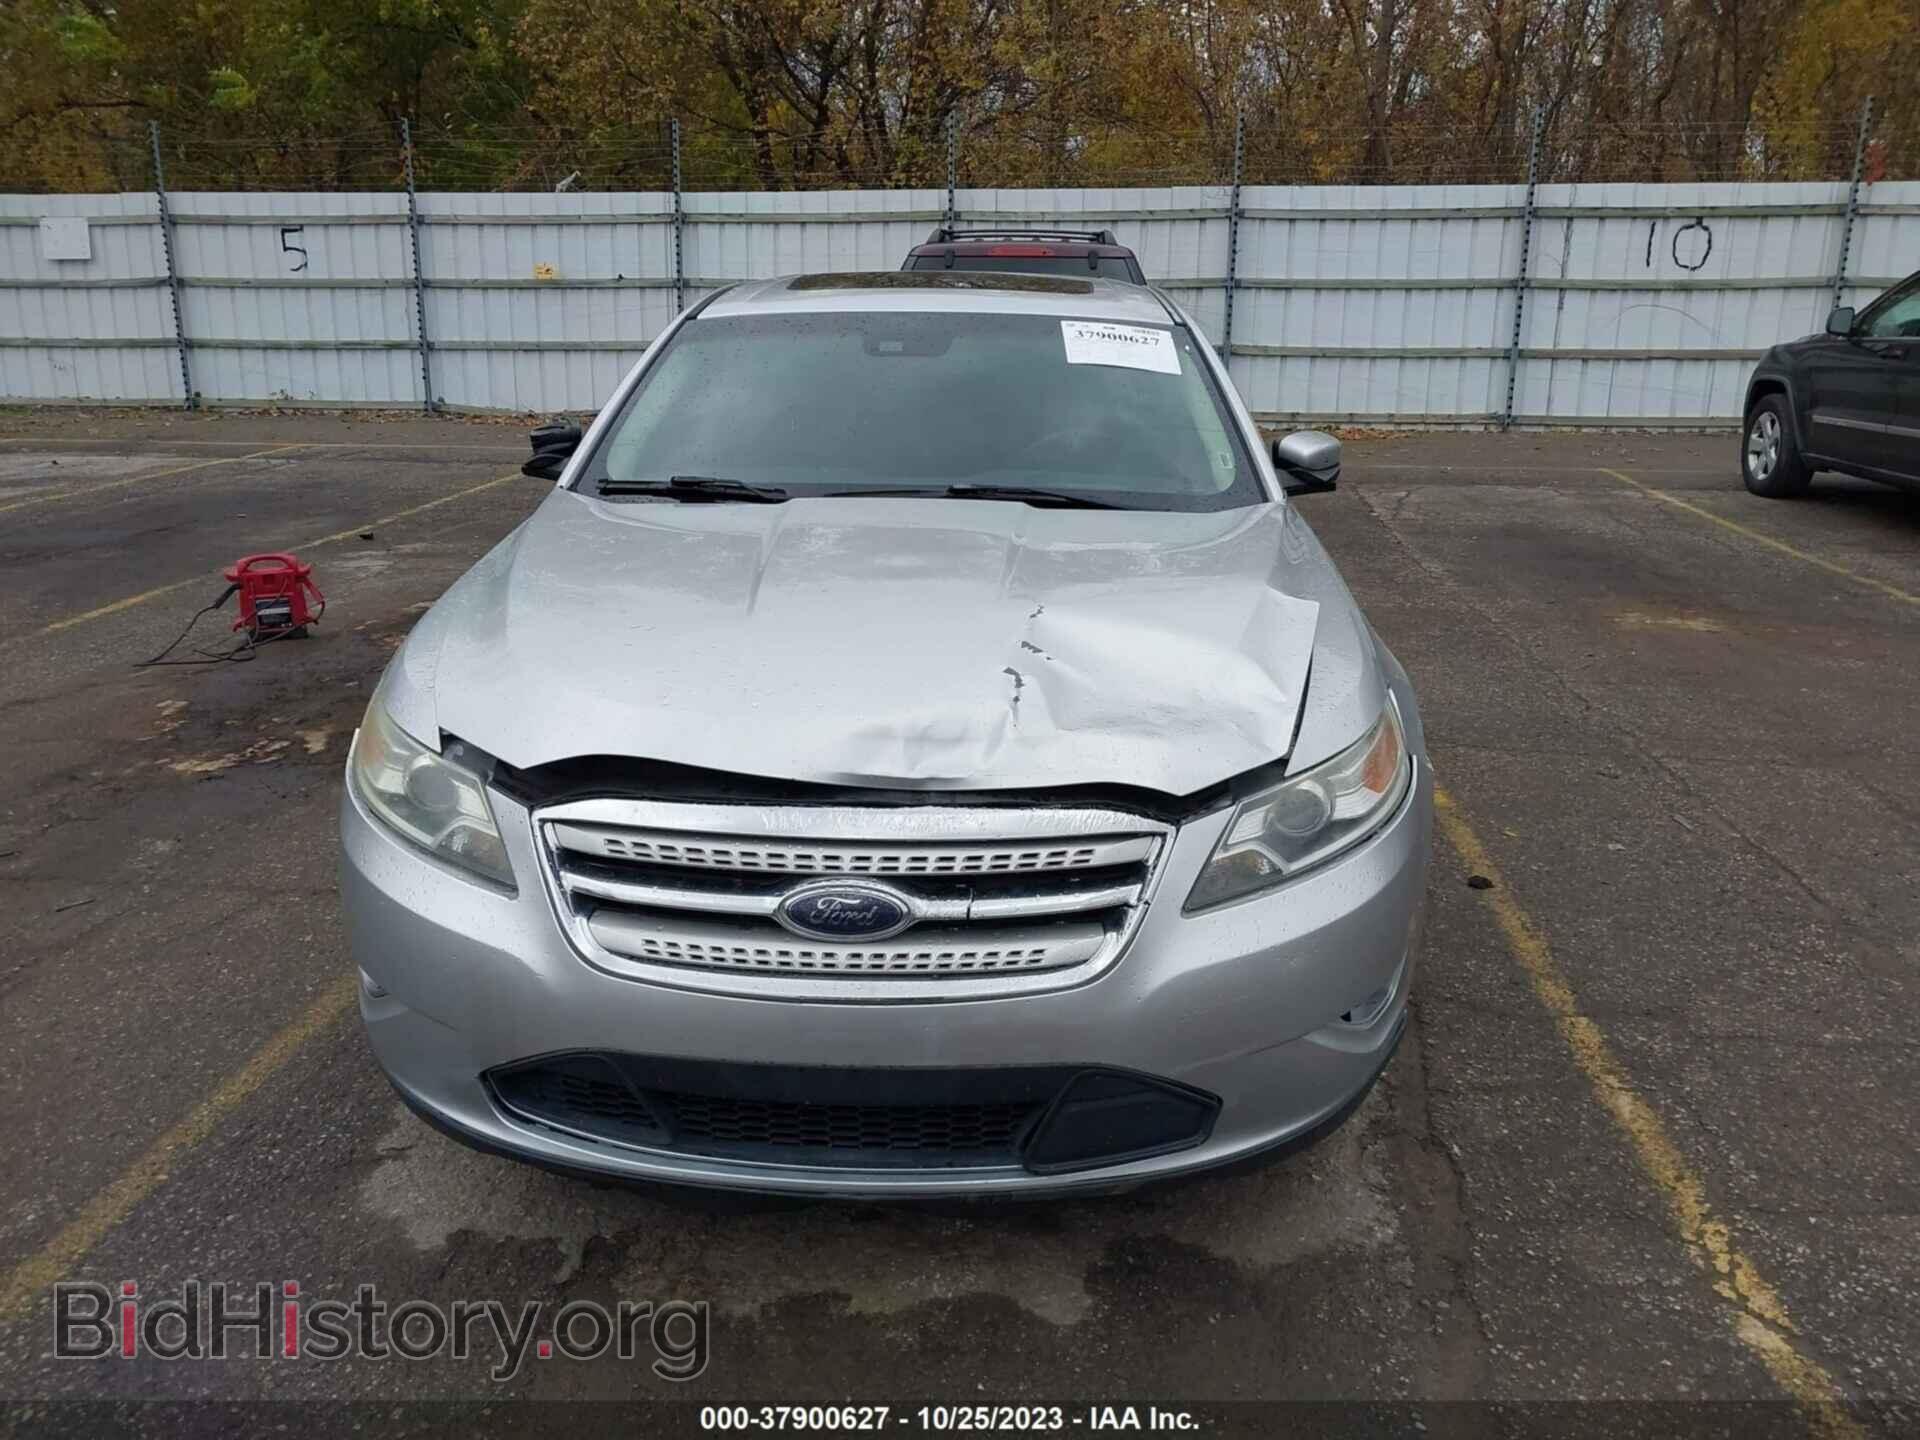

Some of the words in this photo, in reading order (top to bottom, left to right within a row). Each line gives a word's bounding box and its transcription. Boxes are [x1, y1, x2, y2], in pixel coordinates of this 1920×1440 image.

[280, 225, 308, 272] 5
[1645, 220, 1712, 272] 10
[1074, 329, 1160, 347] 37900627
[809, 896, 878, 926] Ford
